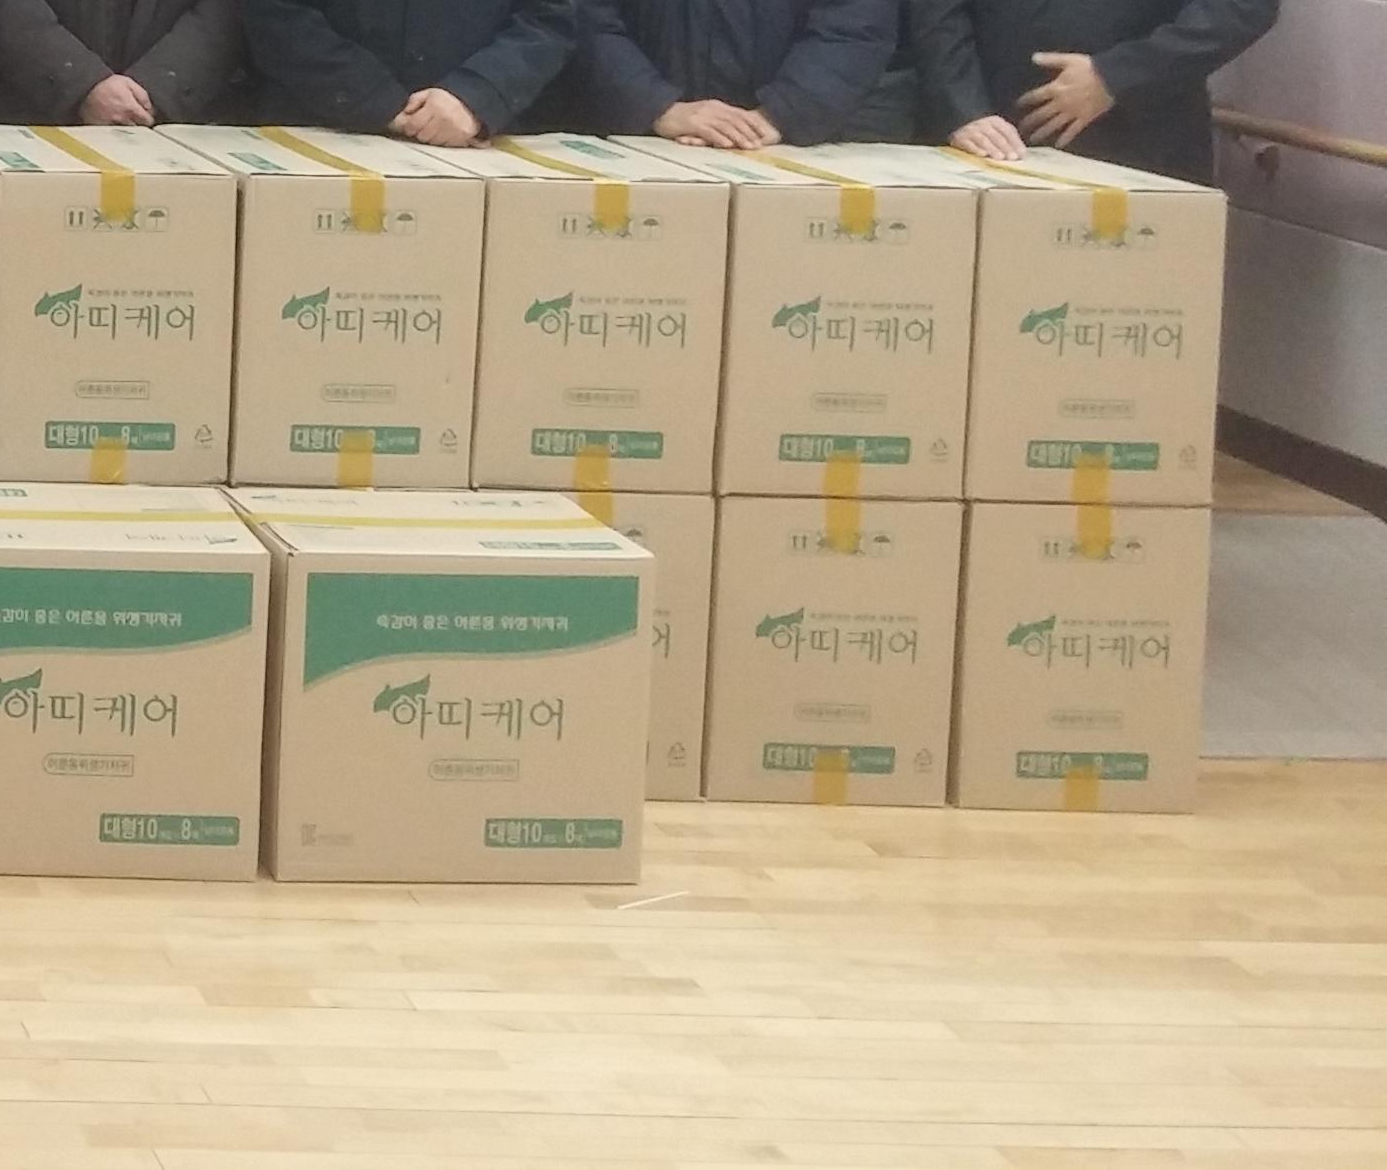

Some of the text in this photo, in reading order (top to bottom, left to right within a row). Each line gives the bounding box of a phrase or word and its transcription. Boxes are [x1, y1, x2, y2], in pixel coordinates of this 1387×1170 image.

[49, 303, 196, 340] 아띠케어
[296, 306, 443, 344] 아띠케어
[540, 311, 687, 349] 아띠케어
[787, 315, 935, 353] 아띠케어
[1035, 321, 1185, 359] 아띠케어
[772, 627, 919, 664] 아띠케어
[1023, 634, 1170, 669] 아띠케어
[4, 691, 178, 737] 아띠케어
[392, 698, 564, 740] 아띠케어
